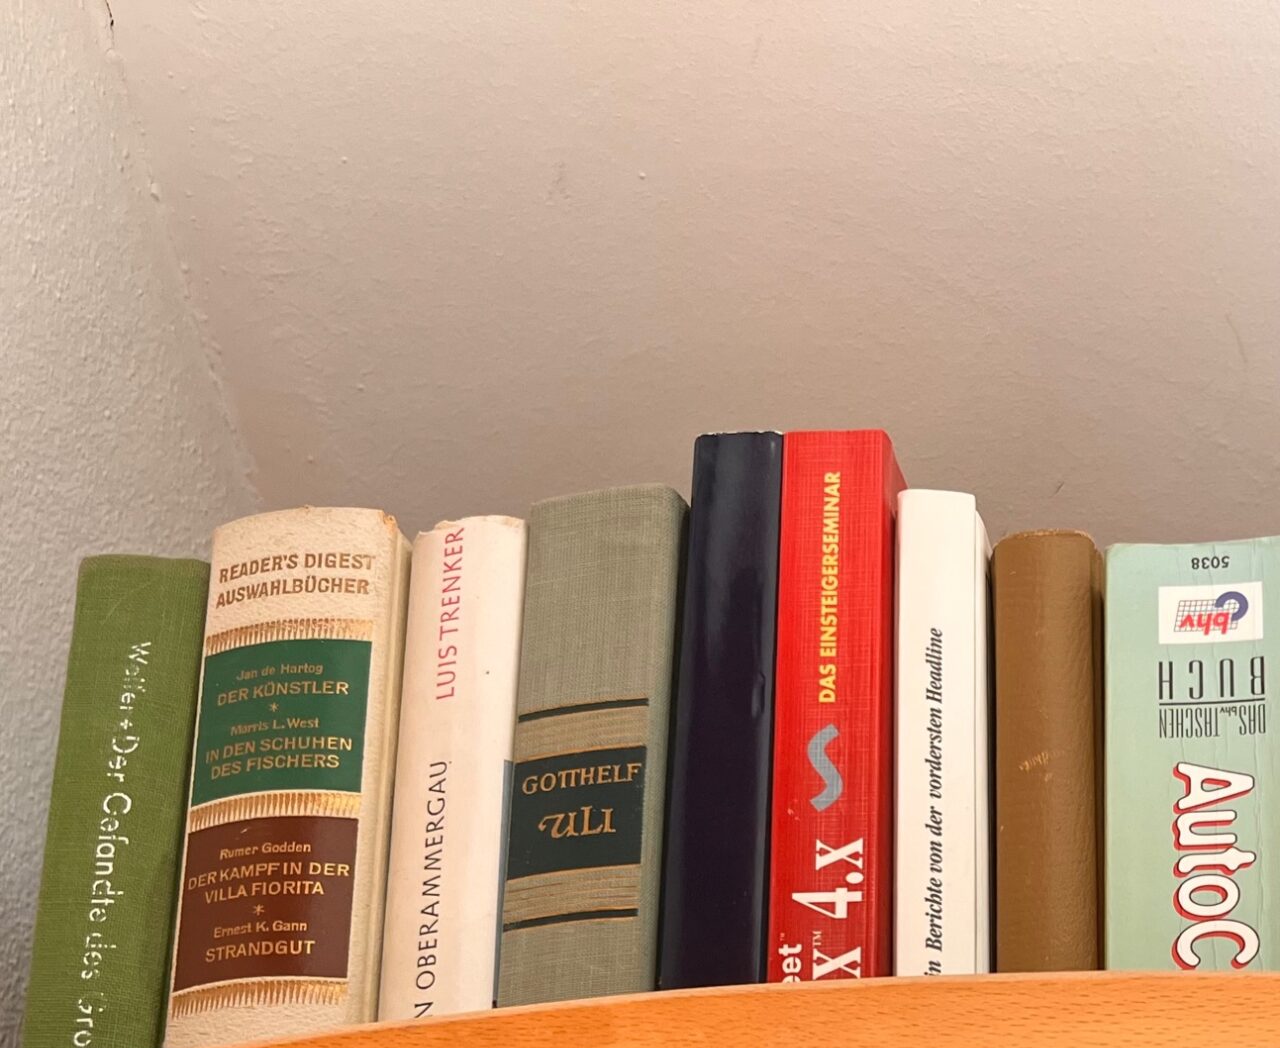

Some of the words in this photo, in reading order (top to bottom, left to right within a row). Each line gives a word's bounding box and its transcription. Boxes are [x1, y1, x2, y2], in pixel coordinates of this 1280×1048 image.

[219, 554, 299, 583] READER'S
[304, 553, 376, 570] DIGEST
[820, 472, 841, 657] EINSTEIGERSEMINAR
[1192, 556, 1230, 569] 5038
[216, 575, 370, 609] AUSWAHLBÜCHER
[439, 527, 464, 641] TRENKER
[1180, 612, 1231, 635] bhv
[236, 669, 258, 681] Jan
[261, 666, 275, 677] de
[281, 663, 324, 675] Hartog
[436, 645, 457, 700] LUIS
[925, 628, 943, 704] Headline
[1158, 656, 1265, 700] BUCH
[217, 688, 248, 706] DER
[253, 681, 349, 699] KÜNSTLER
[819, 664, 837, 703] DAS
[230, 720, 269, 736] Morris
[1159, 707, 1220, 738] TASCHEN
[1239, 704, 1266, 735] DAS
[107, 735, 140, 782] Der
[206, 751, 219, 764] IN
[223, 743, 256, 759] DEN
[260, 737, 353, 752] SCHUHEN
[924, 707, 942, 799] vordersten
[211, 761, 242, 780] DES
[247, 755, 340, 772] FISCHERS
[522, 762, 642, 795] GOTTHELF
[925, 806, 943, 837] der
[220, 847, 258, 860] Rumer
[262, 842, 311, 854] Godden
[929, 841, 943, 873] von
[1173, 762, 1261, 970] AutoC
[188, 872, 217, 890] DER
[219, 863, 280, 882] KAMPF
[283, 862, 302, 875] IN
[309, 863, 350, 877] DER
[416, 761, 448, 990] OBERAMMERGAU
[204, 885, 248, 904] VILLA
[251, 881, 325, 896] FIORITA
[213, 923, 252, 939] Ernest
[256, 921, 269, 932] K.
[272, 920, 307, 932] Gann
[924, 877, 942, 951] Berichte
[205, 940, 315, 963] STRANDGUT
